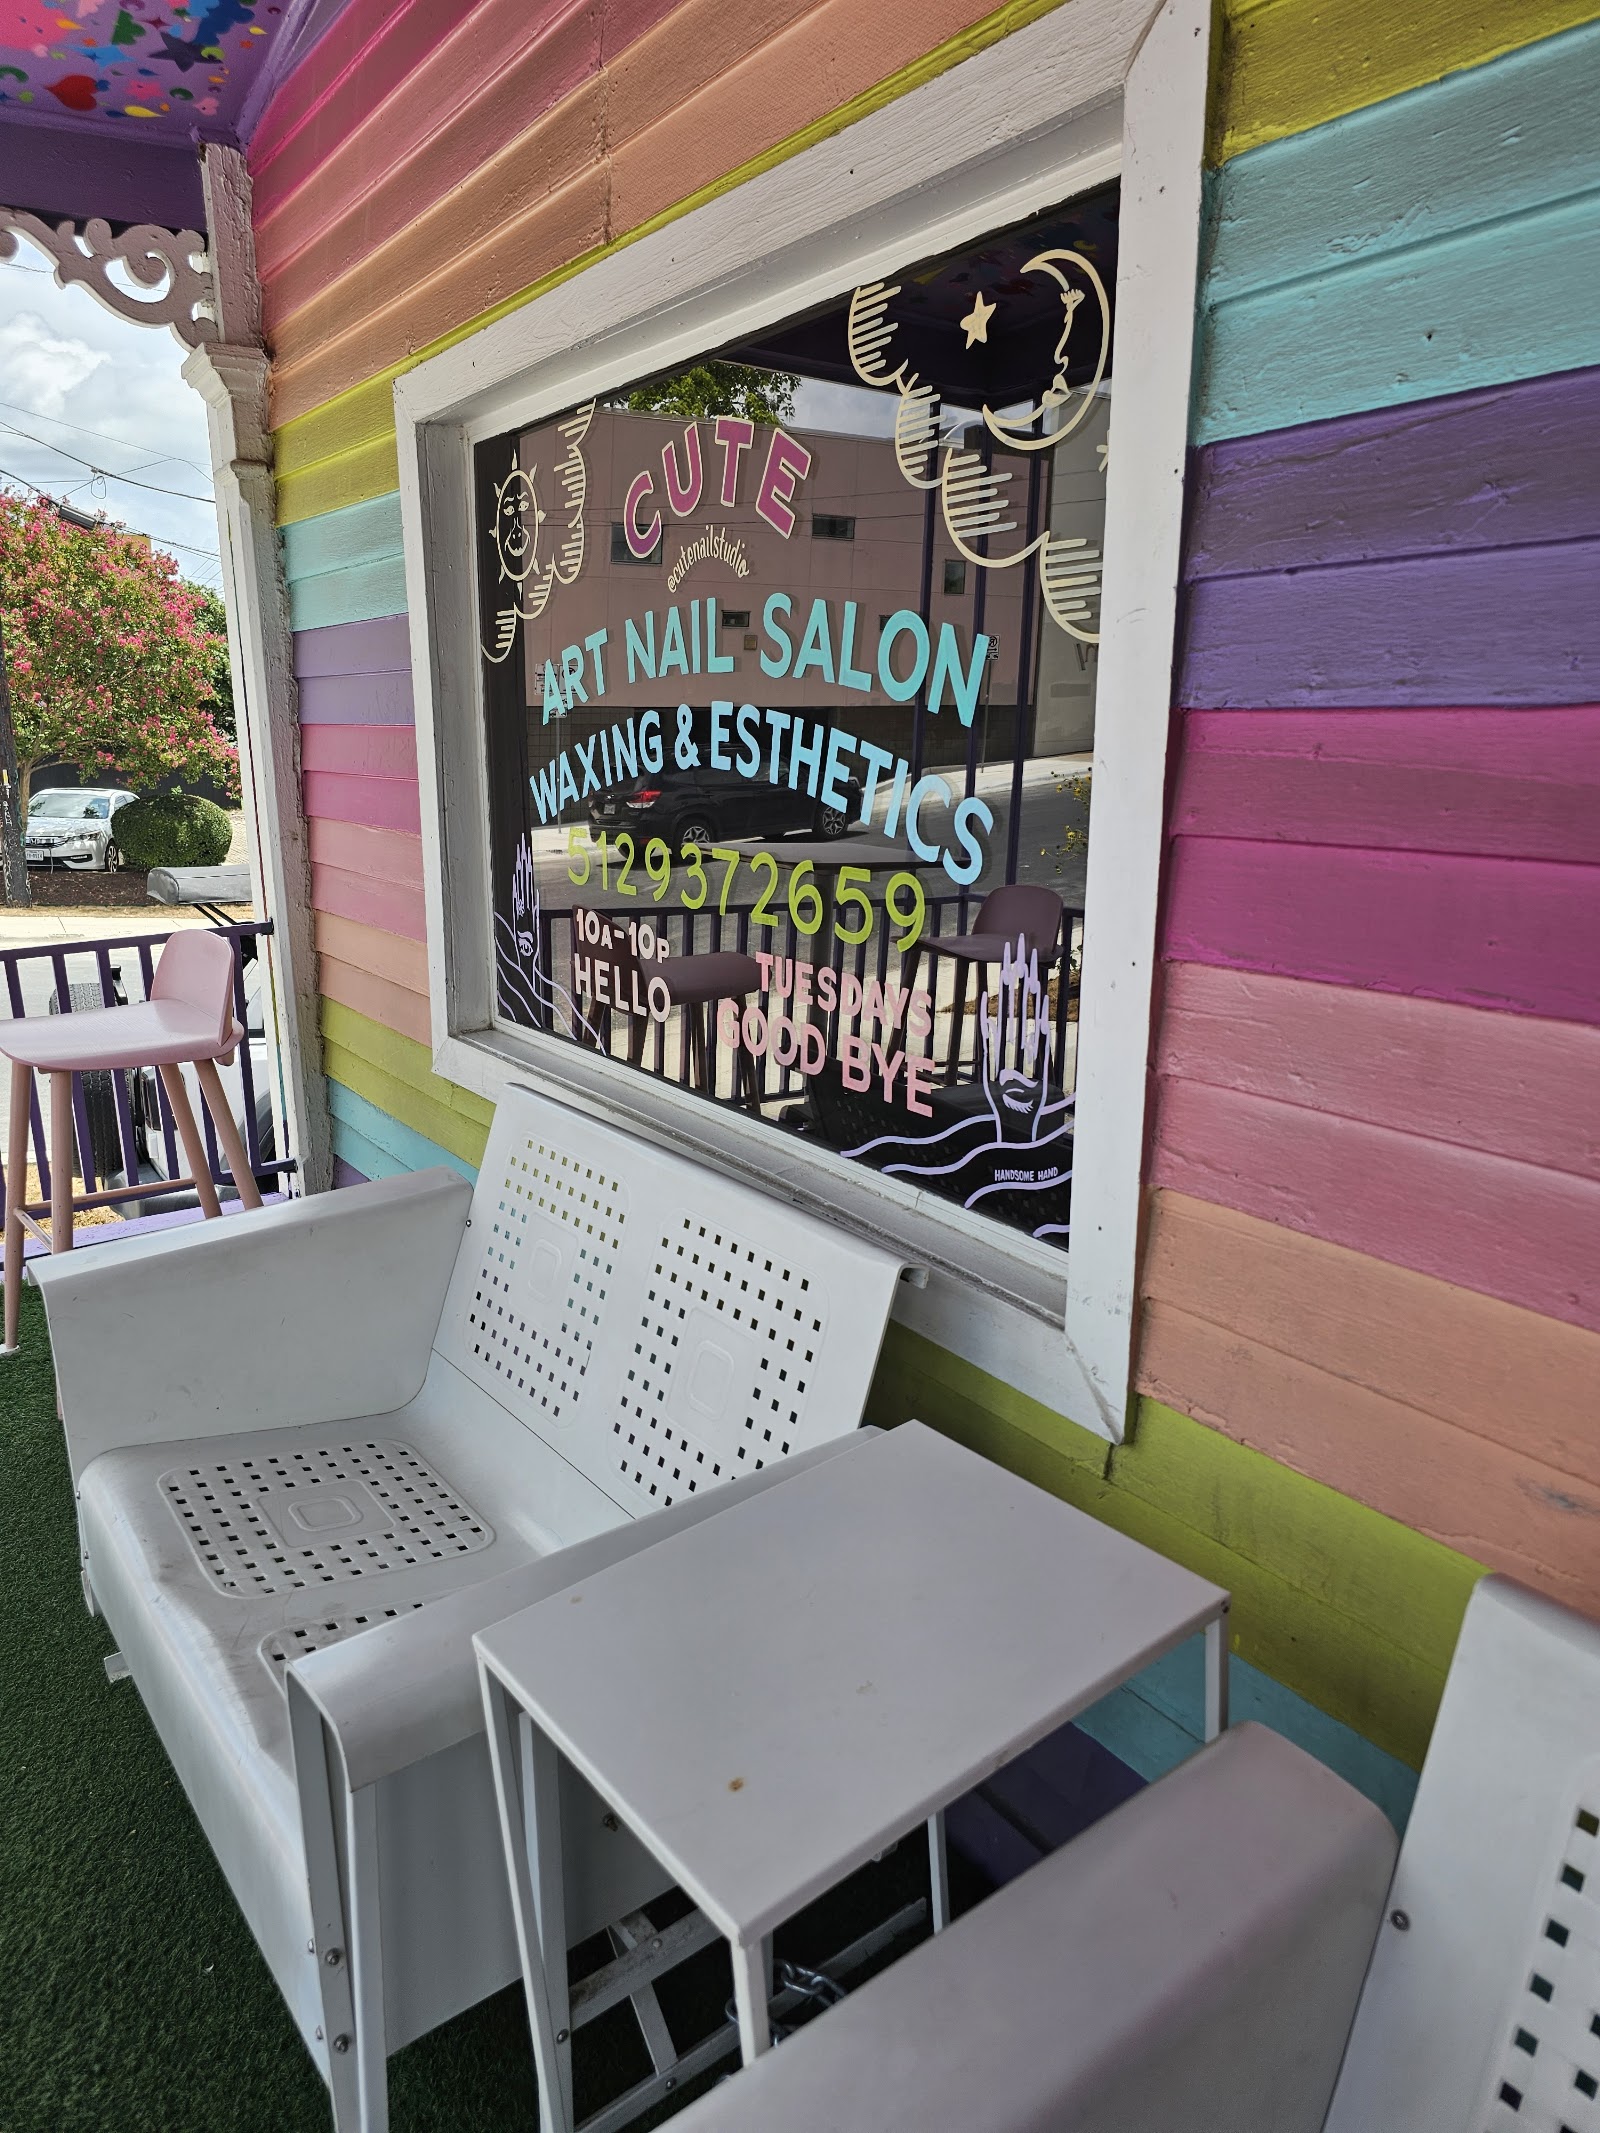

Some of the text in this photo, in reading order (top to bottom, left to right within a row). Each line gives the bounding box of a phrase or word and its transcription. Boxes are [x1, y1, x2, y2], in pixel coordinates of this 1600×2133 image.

[623, 415, 812, 559] CUTE
[668, 524, 750, 593] @cutenailstudio
[542, 628, 608, 726] ART
[625, 597, 734, 684] NAIL
[760, 592, 990, 728] SALON
[529, 701, 994, 886] WAXING & ESTHETICS
[567, 826, 926, 953] 5129372659
[574, 953, 671, 1023] HELLO
[755, 951, 932, 1038] TUESDAYS
[716, 998, 936, 1118] GOOD BYE
[994, 1166, 1059, 1182] HANDSOME HAND
